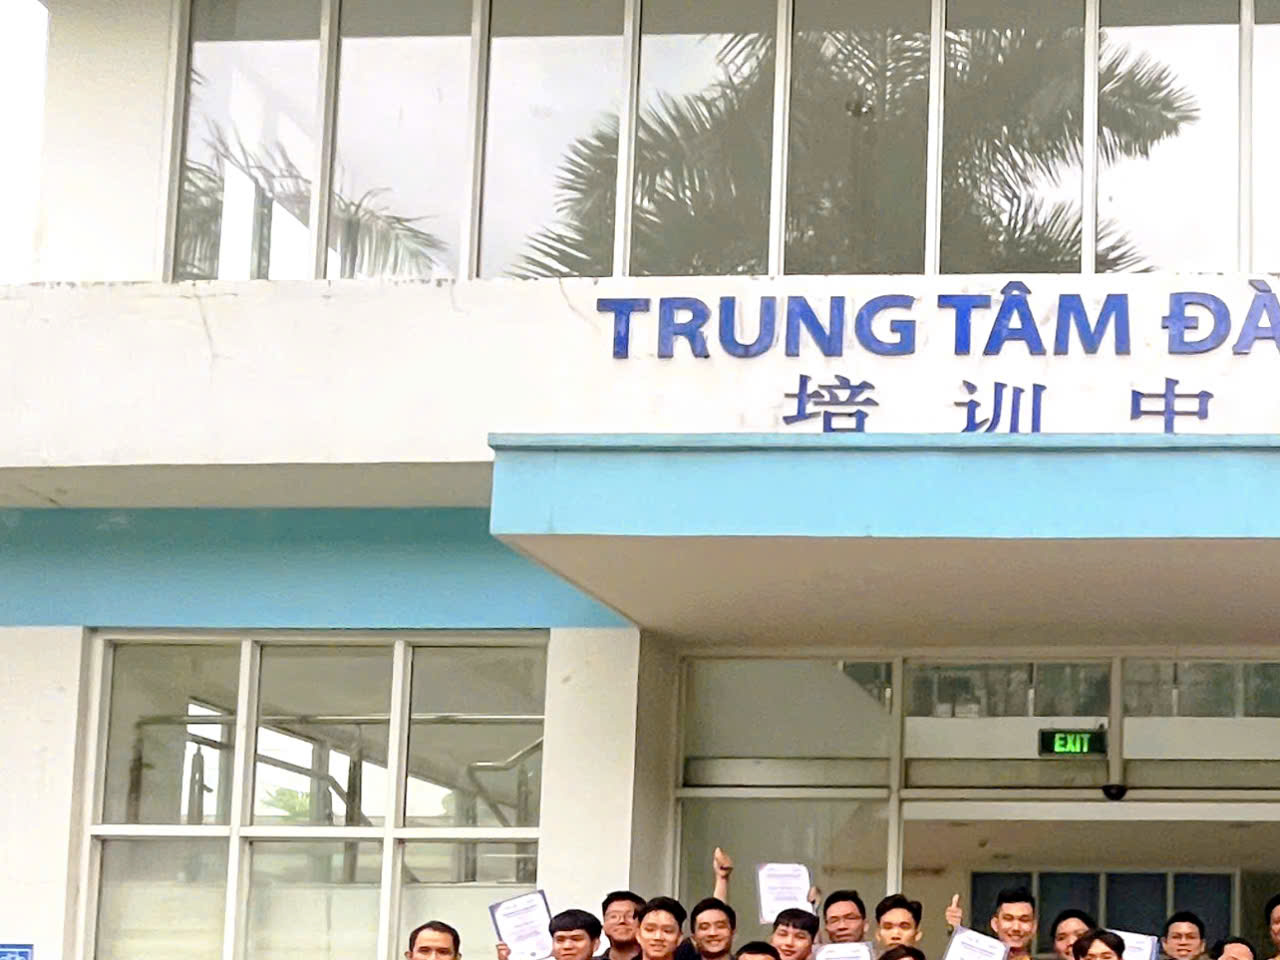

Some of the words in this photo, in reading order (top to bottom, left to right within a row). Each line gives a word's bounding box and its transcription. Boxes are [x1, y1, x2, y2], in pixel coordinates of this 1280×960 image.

[597, 294, 917, 359] TRUNG
[937, 280, 1130, 357] TÂM
[1054, 733, 1091, 752] EXIT
